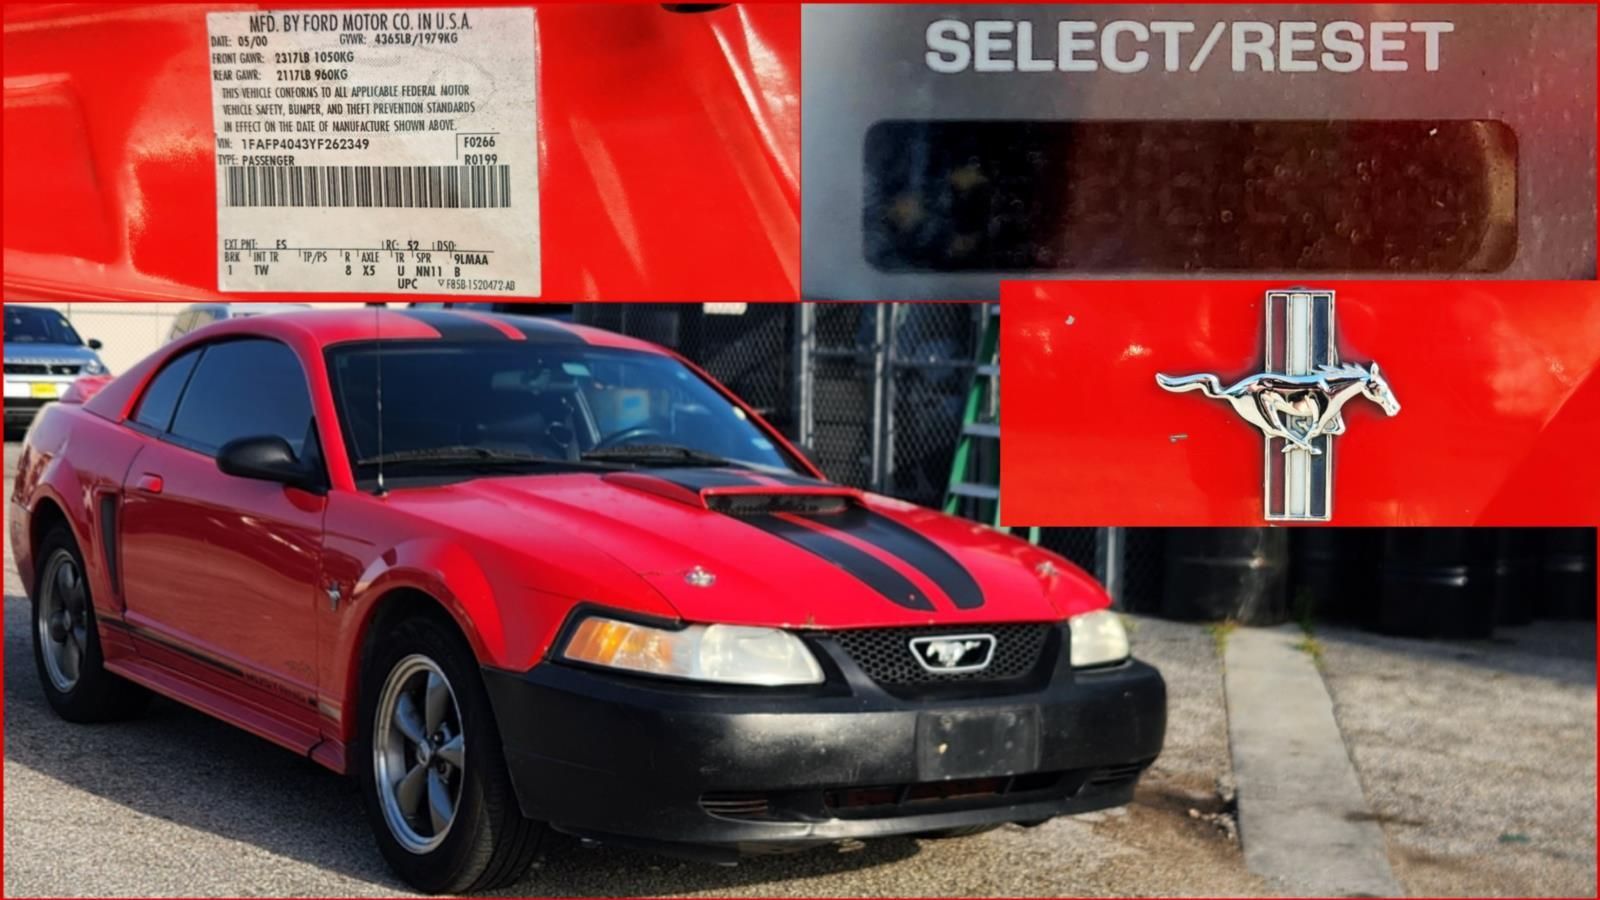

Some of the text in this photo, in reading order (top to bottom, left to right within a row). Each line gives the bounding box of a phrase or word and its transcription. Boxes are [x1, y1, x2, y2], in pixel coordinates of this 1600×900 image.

[250, 12, 473, 33] MFD. BY FORD MOTOR CO. IN U.S.A.
[211, 33, 458, 49] DATE: 05/00 GVWR: 4365LB/1979KG
[925, 19, 1455, 73] SELECT/RESET
[212, 51, 354, 64] FRONT GAWR: 2317LB 1050KG
[213, 69, 348, 81] REAR GAWR: 2117LB 960KG
[222, 84, 470, 99] THIS VEHICLE CONFORMS TO ALL APPLICABLE FEDERAL MOTOR
[223, 102, 475, 116] VEHICLE SAFETY, BUMPER, AND THEFT PREVENTION STANDARDS
[224, 119, 457, 132] IN EFFECT ON THE DATE OF MANUFACTURE SHOWN ABOVE.
[217, 136, 496, 150] VIN: 1FAFP4043YF262349 F0266
[217, 154, 498, 166] TYPE: PASSENGER R0199
[224, 239, 238, 250] EXT
[276, 239, 287, 249] ES
[407, 240, 419, 251] 52
[224, 251, 488, 265] BRK INT TR TP/PS R AXLE TR SPR 9LMAA
[228, 265, 461, 277] 1 TW 8 X5 U NN11 B
[398, 278, 418, 289] UPC
